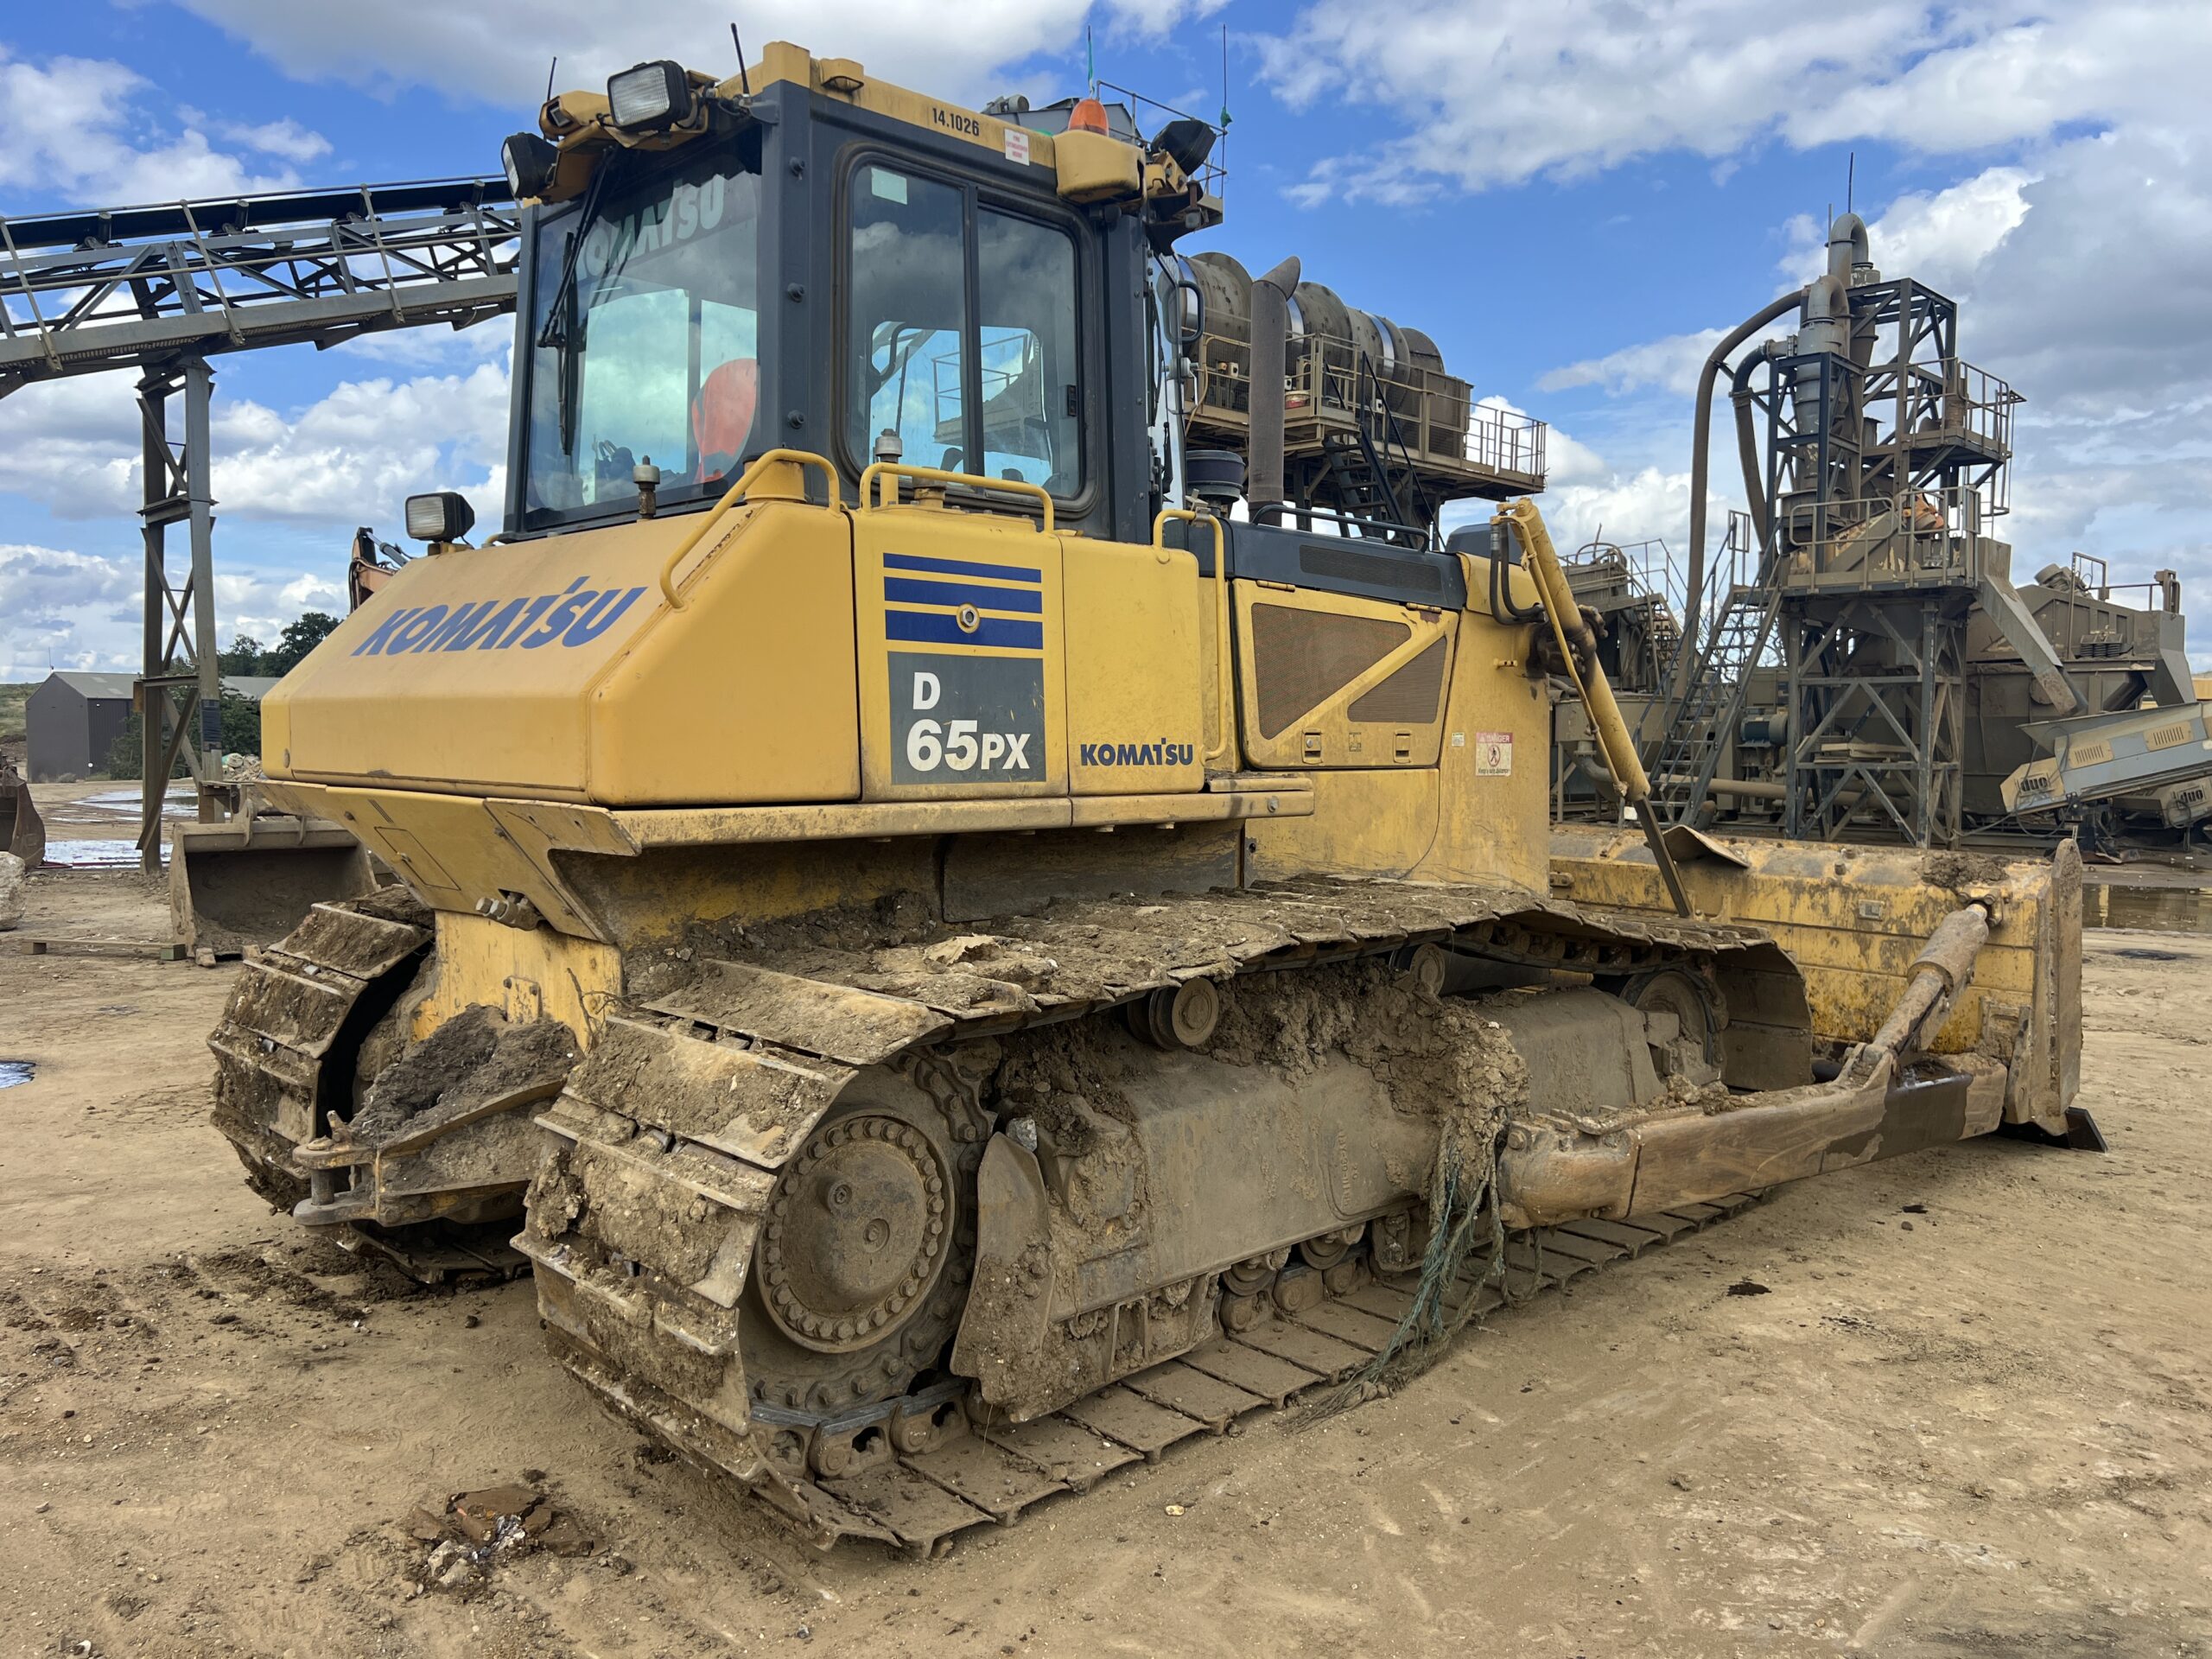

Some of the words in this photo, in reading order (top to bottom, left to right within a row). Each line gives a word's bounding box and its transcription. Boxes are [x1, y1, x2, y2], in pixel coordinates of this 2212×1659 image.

[932, 107, 980, 137] 14.1026
[349, 575, 648, 657] KOMATSU
[912, 671, 941, 710] D
[906, 718, 1031, 772] 65PX
[1080, 737, 1193, 766] KOMATSU
[2020, 777, 2048, 792] duo
[2180, 788, 2203, 804] duo
